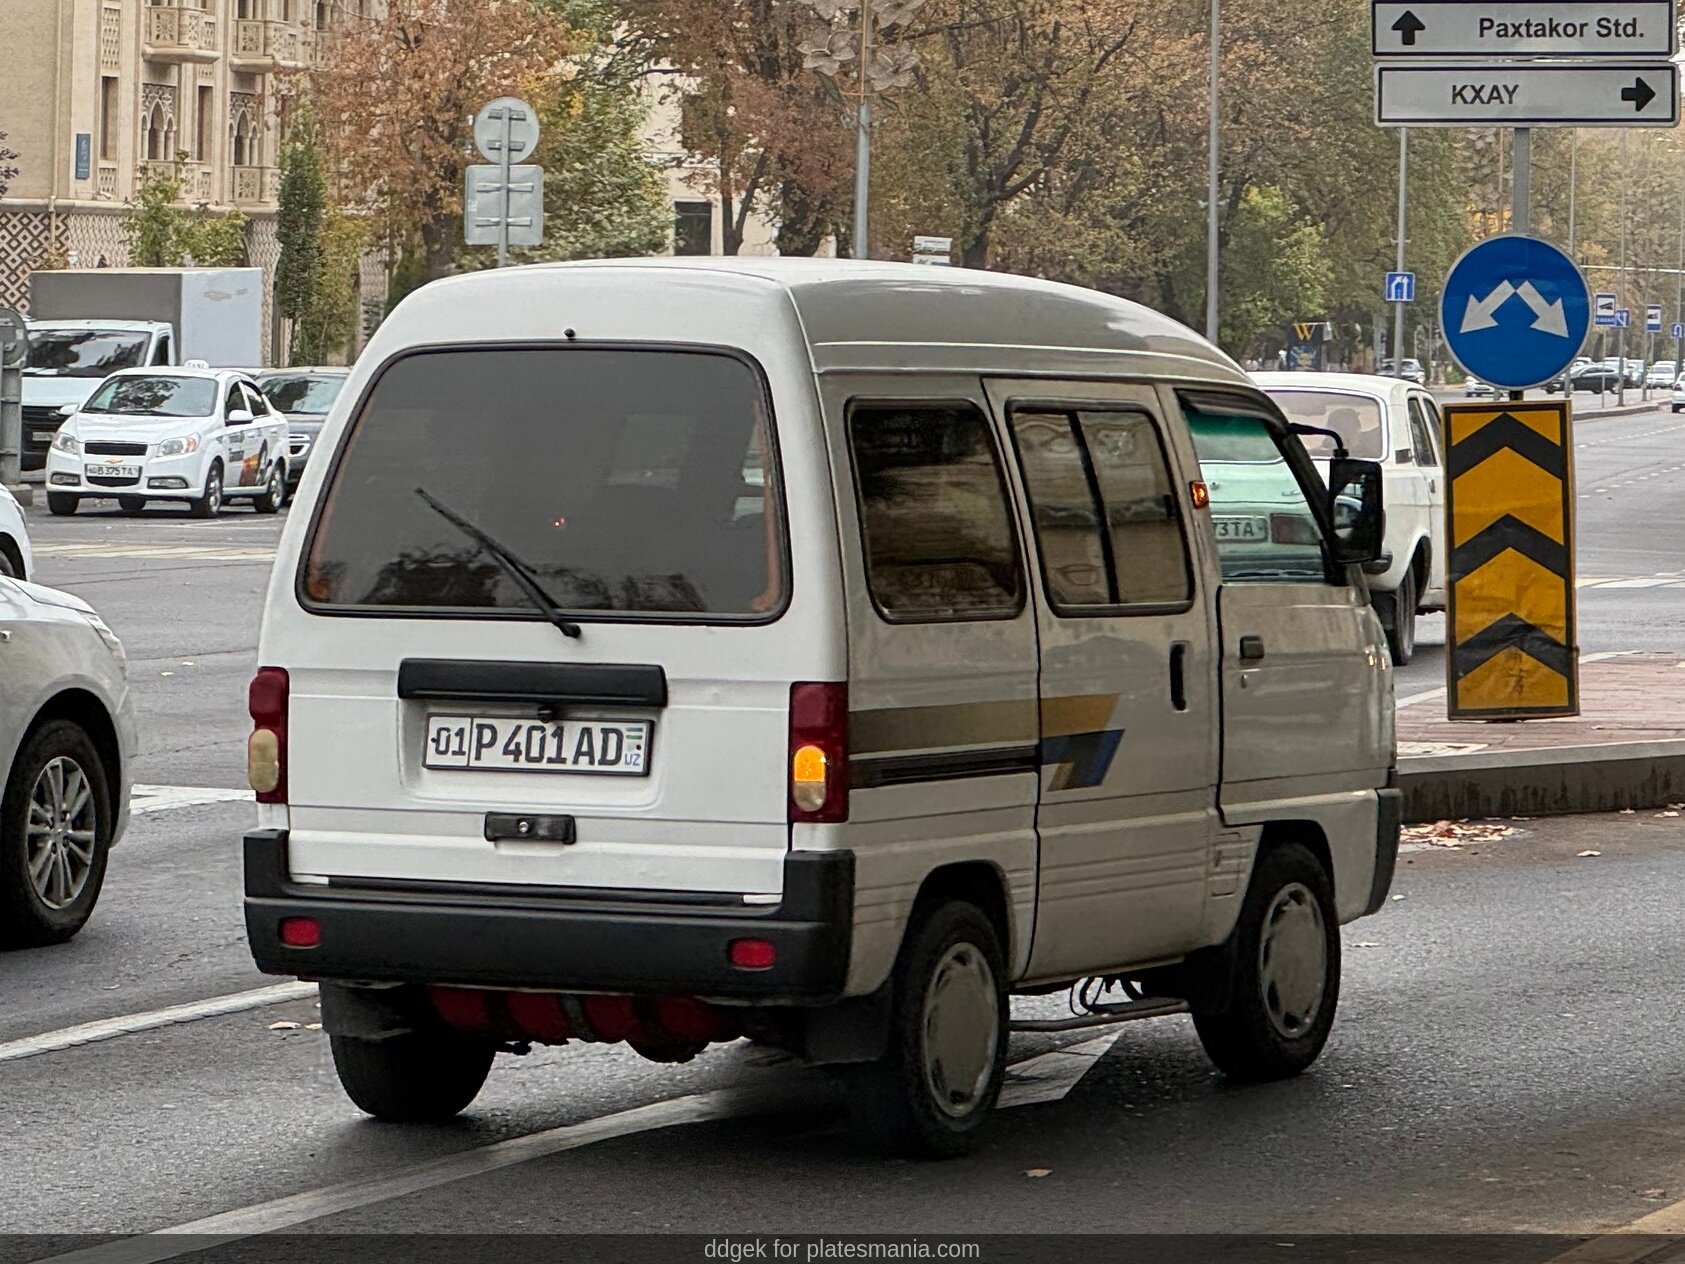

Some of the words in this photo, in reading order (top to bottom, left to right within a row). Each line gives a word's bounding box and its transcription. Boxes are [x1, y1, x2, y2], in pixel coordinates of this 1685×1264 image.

[1479, 17, 1588, 38] Paxtakor
[1596, 17, 1644, 38] Std.
[1451, 84, 1520, 105] KXAY
[434, 726, 467, 756] 01
